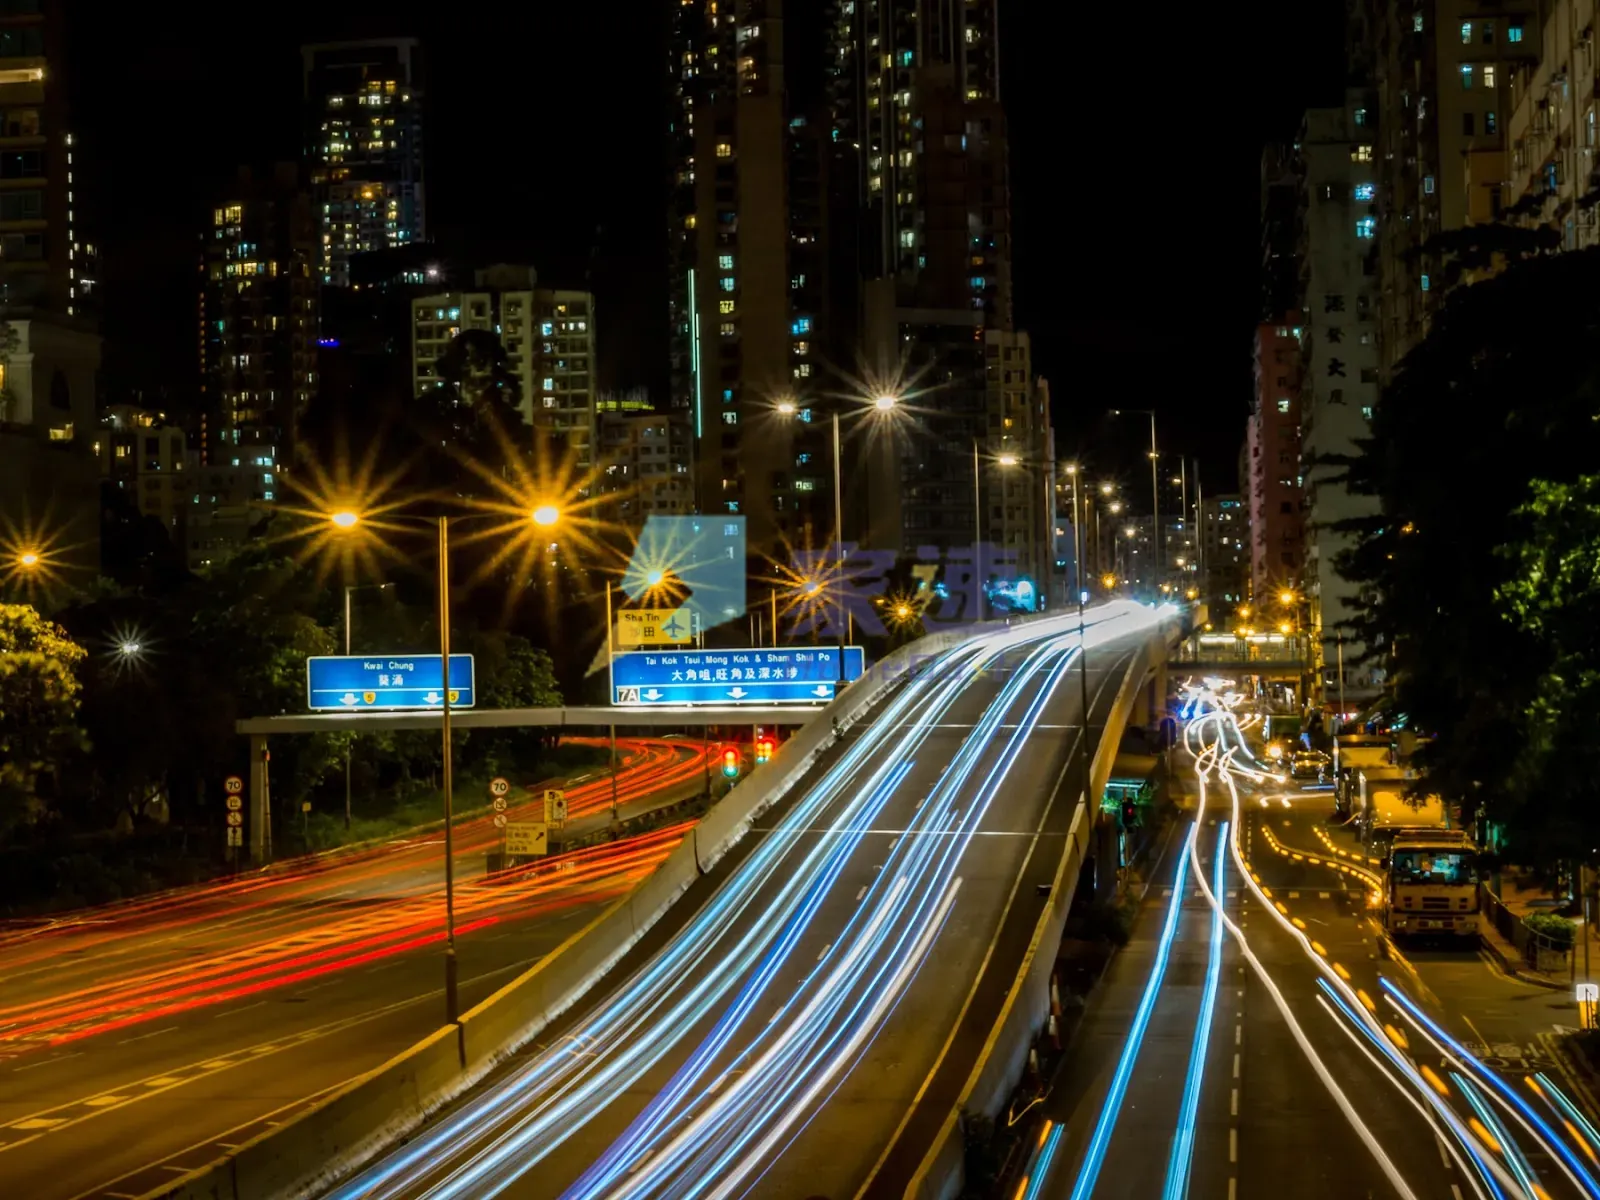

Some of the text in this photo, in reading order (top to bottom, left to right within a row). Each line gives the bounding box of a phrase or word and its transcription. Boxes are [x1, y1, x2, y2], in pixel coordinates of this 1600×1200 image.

[624, 613, 660, 622] Sha Tin
[629, 625, 655, 637] 沙田
[645, 656, 657, 666] Tai
[661, 656, 678, 665] Kok
[705, 655, 728, 665] Mong
[733, 654, 749, 664] Kok
[754, 654, 762, 663] &
[767, 653, 790, 663] Sham
[795, 653, 814, 662] Shui
[818, 653, 830, 662] Po
[363, 661, 414, 671] Kwai Chung
[378, 674, 404, 686] 葵涌
[619, 688, 638, 700] 7A
[227, 781, 241, 790] 70
[494, 782, 507, 792] 70
